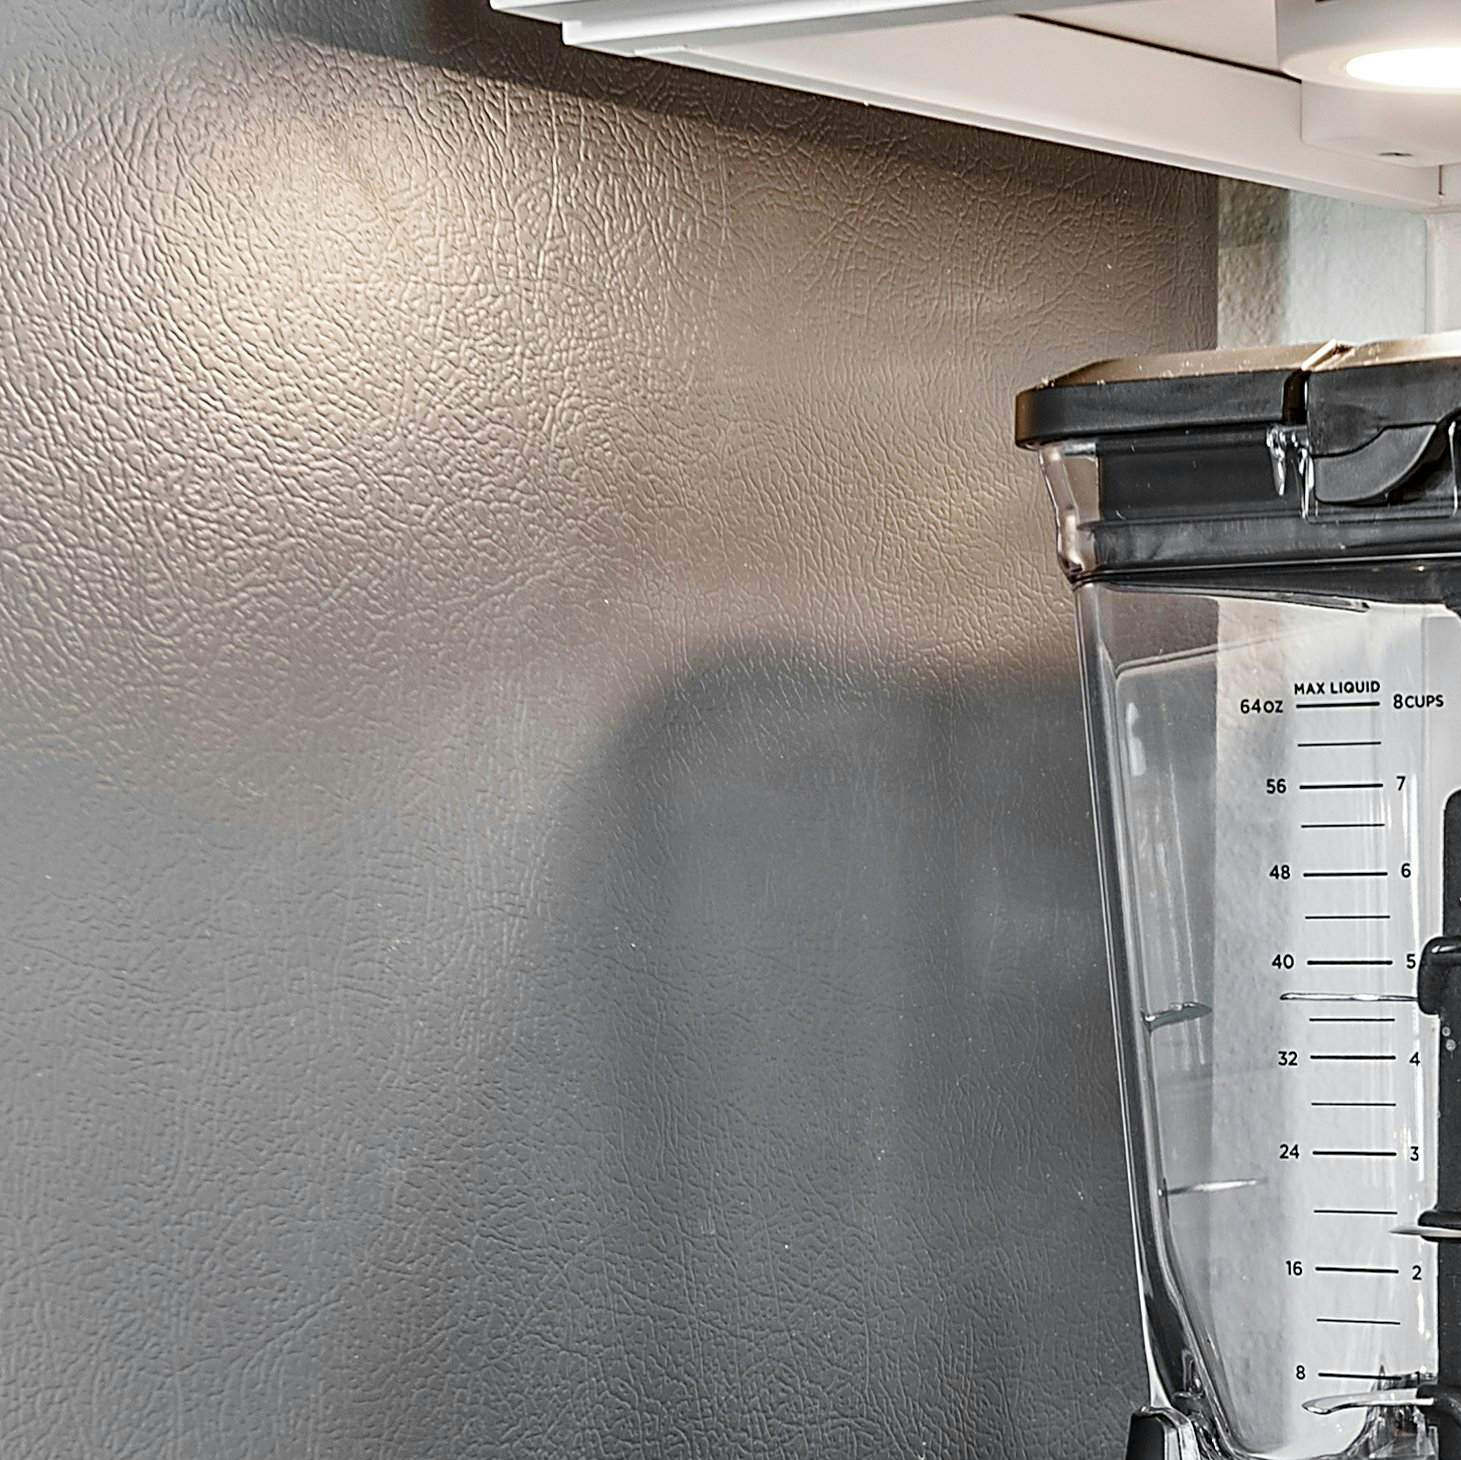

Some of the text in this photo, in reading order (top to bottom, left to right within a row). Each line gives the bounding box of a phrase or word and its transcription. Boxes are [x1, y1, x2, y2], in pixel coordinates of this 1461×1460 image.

[1294, 681, 1381, 695] MAX LIQUID
[1266, 779, 1287, 794] 56
[1396, 776, 1406, 791] 7
[1269, 865, 1291, 880] 48
[1401, 863, 1411, 878] 6
[1271, 954, 1295, 970] 40
[1406, 954, 1416, 970] 5
[1278, 1051, 1298, 1067] 32
[1409, 1052, 1421, 1067] 4
[1279, 1144, 1300, 1159] 24
[1409, 1146, 1419, 1161] 3
[1286, 1261, 1303, 1276] 16
[1411, 1265, 1422, 1281] 2
[1296, 1365, 1306, 1380] 8
